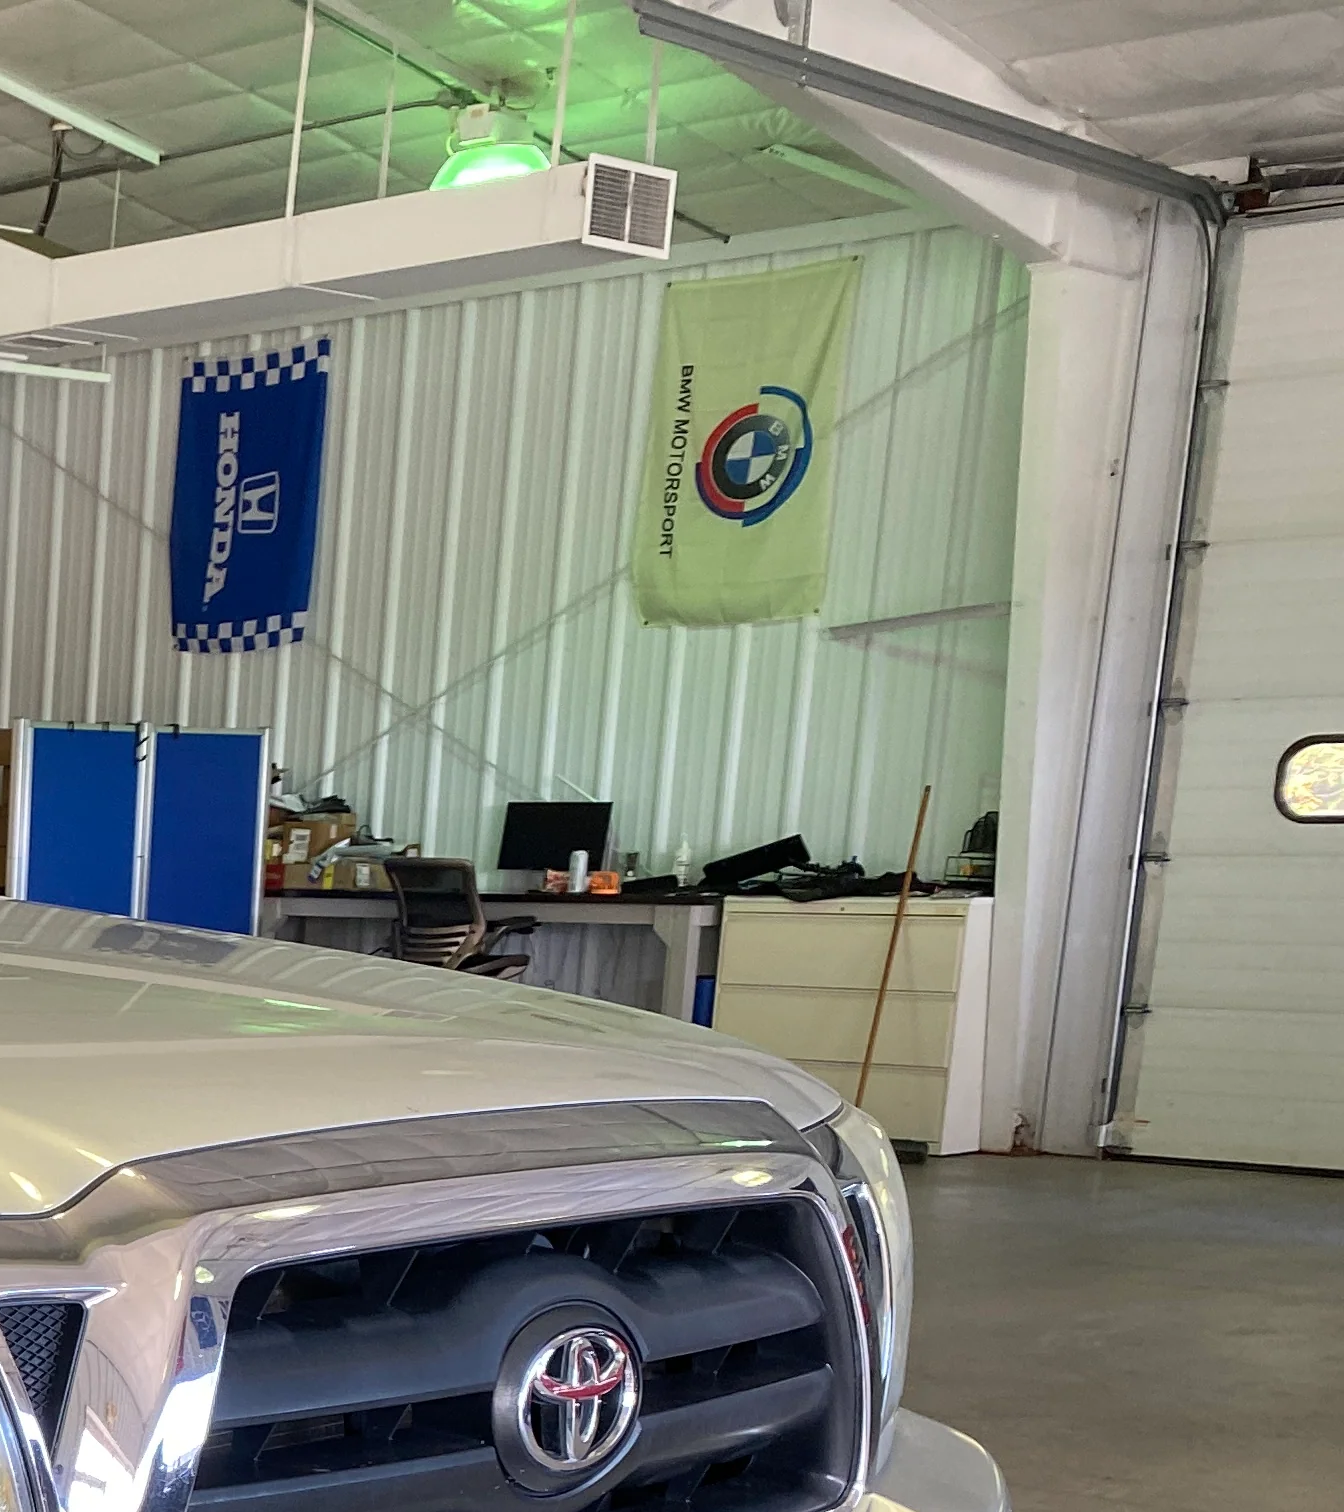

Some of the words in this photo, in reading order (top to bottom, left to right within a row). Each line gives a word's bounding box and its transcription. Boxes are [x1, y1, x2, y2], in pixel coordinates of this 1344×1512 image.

[677, 364, 695, 413] BMW
[203, 411, 241, 604] HONDA
[659, 419, 690, 559] MOTORSPORT
